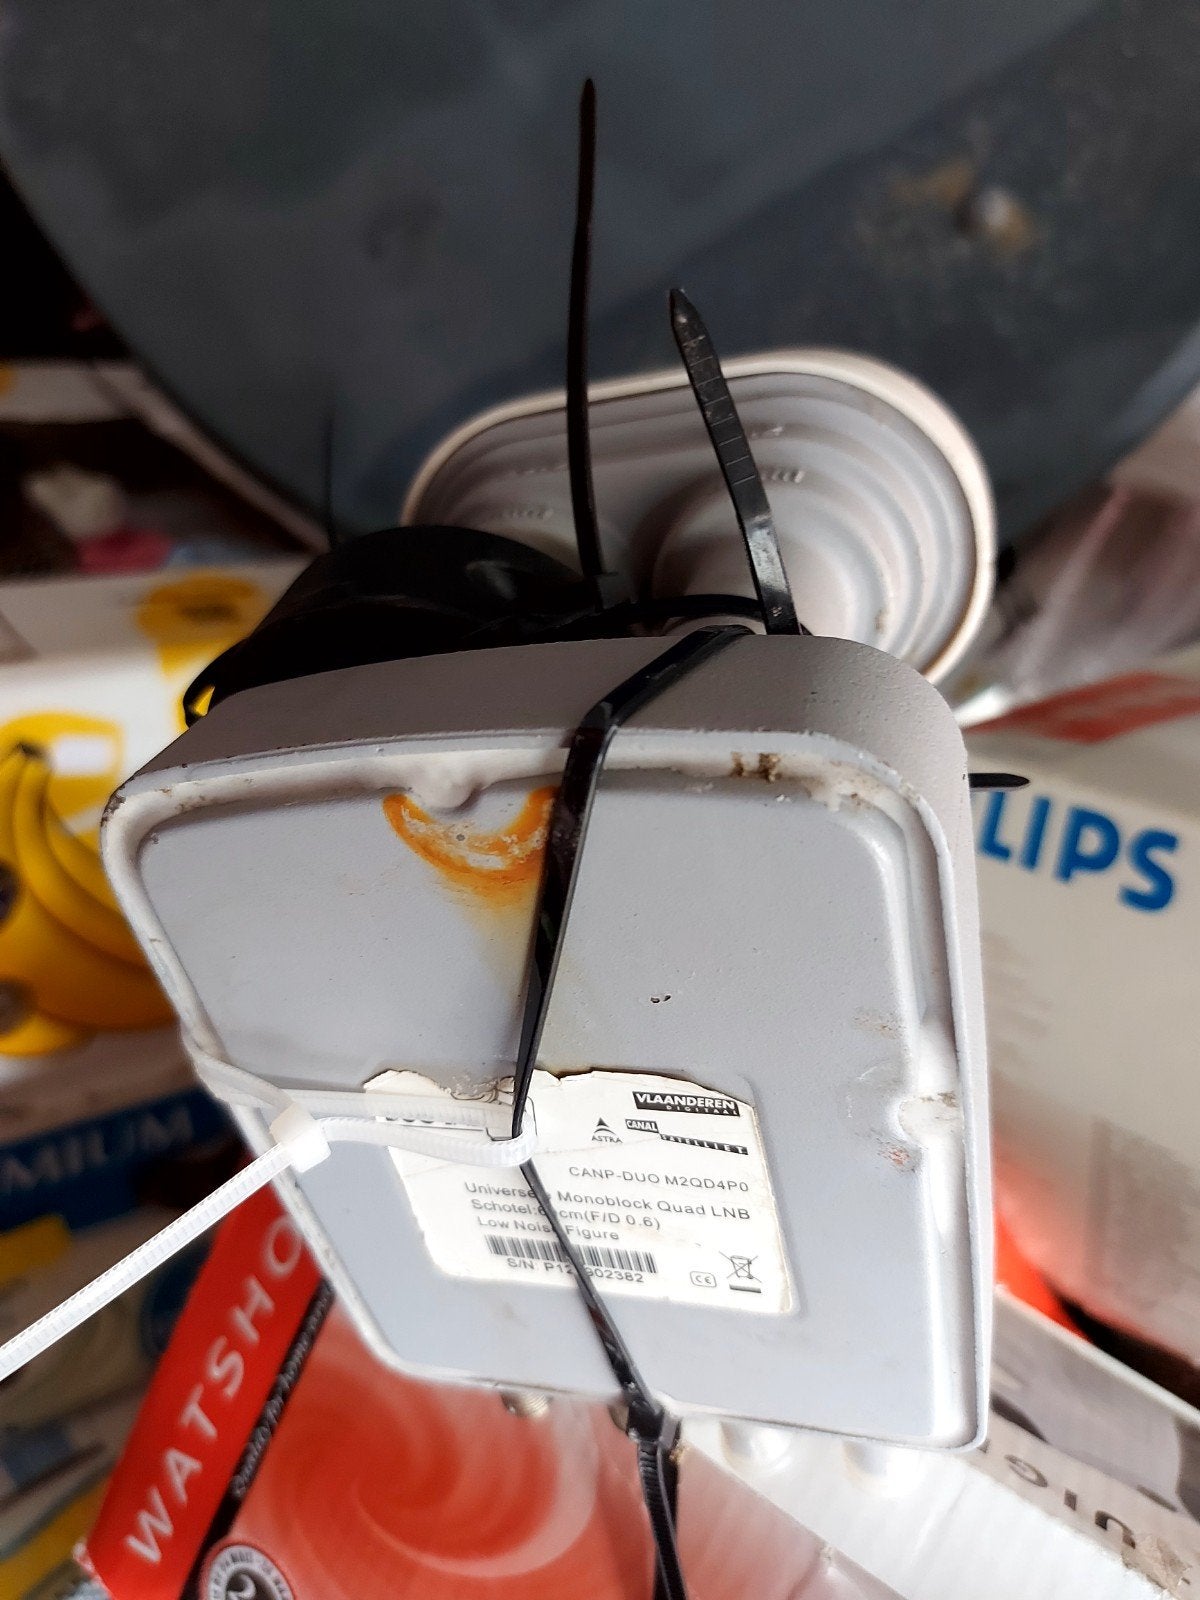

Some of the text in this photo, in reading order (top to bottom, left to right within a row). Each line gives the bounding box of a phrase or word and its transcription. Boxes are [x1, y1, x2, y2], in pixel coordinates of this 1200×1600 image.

[635, 1092, 736, 1110] VLAANDEREN
[626, 1119, 658, 1132] CANAL
[591, 1134, 623, 1144] ASTRA
[568, 1166, 660, 1184] CANP-DUO
[557, 1191, 652, 1210] Monoblock
[657, 1200, 706, 1216] Quad
[711, 1205, 751, 1220] LNB
[477, 1216, 620, 1241] Low Nois Figure
[545, 1262, 645, 1283] P12902382
